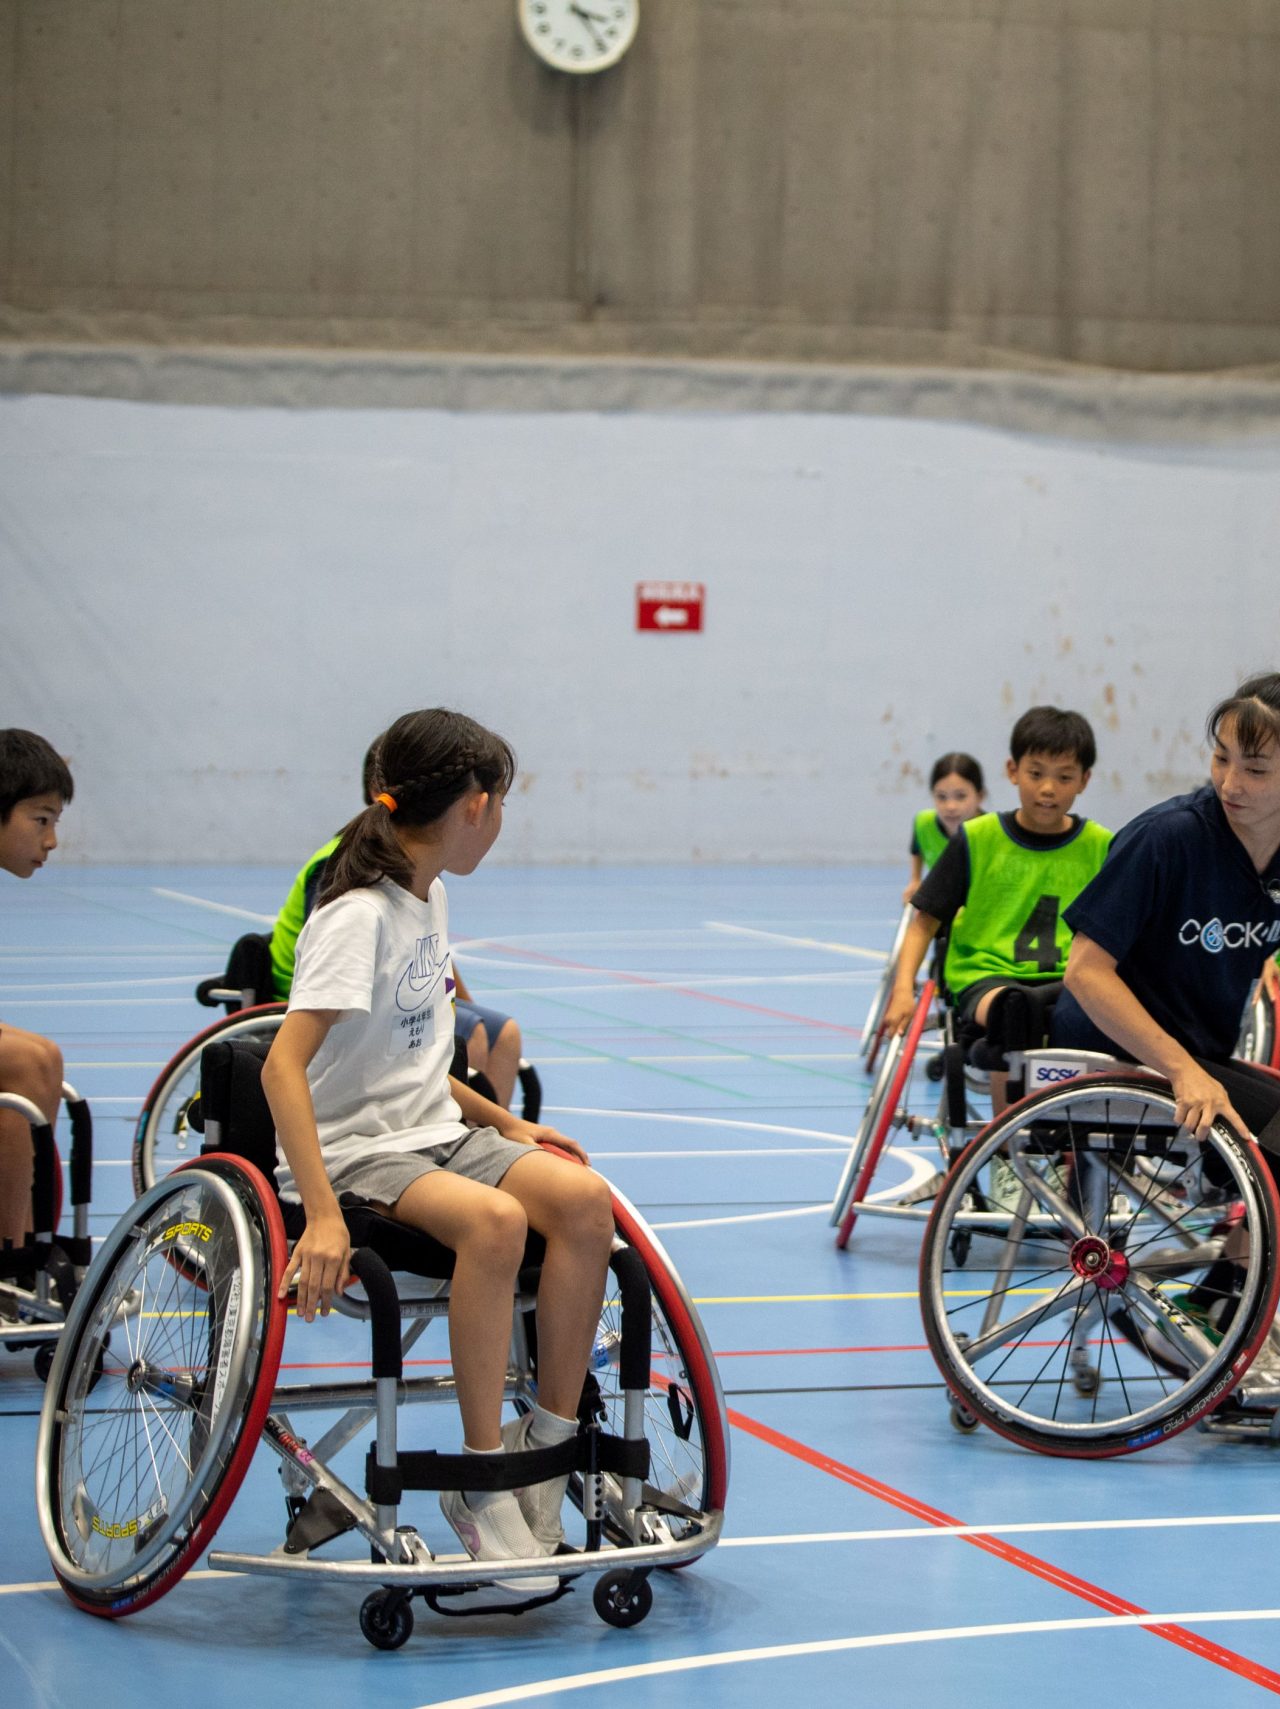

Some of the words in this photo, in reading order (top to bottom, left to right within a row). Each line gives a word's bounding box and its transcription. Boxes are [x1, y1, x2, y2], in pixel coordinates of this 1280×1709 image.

[1014, 894, 1062, 972] 4
[1036, 1067, 1081, 1082] SCSK
[165, 1221, 213, 1243] SPORTS
[92, 1515, 138, 1540] SPORTS
